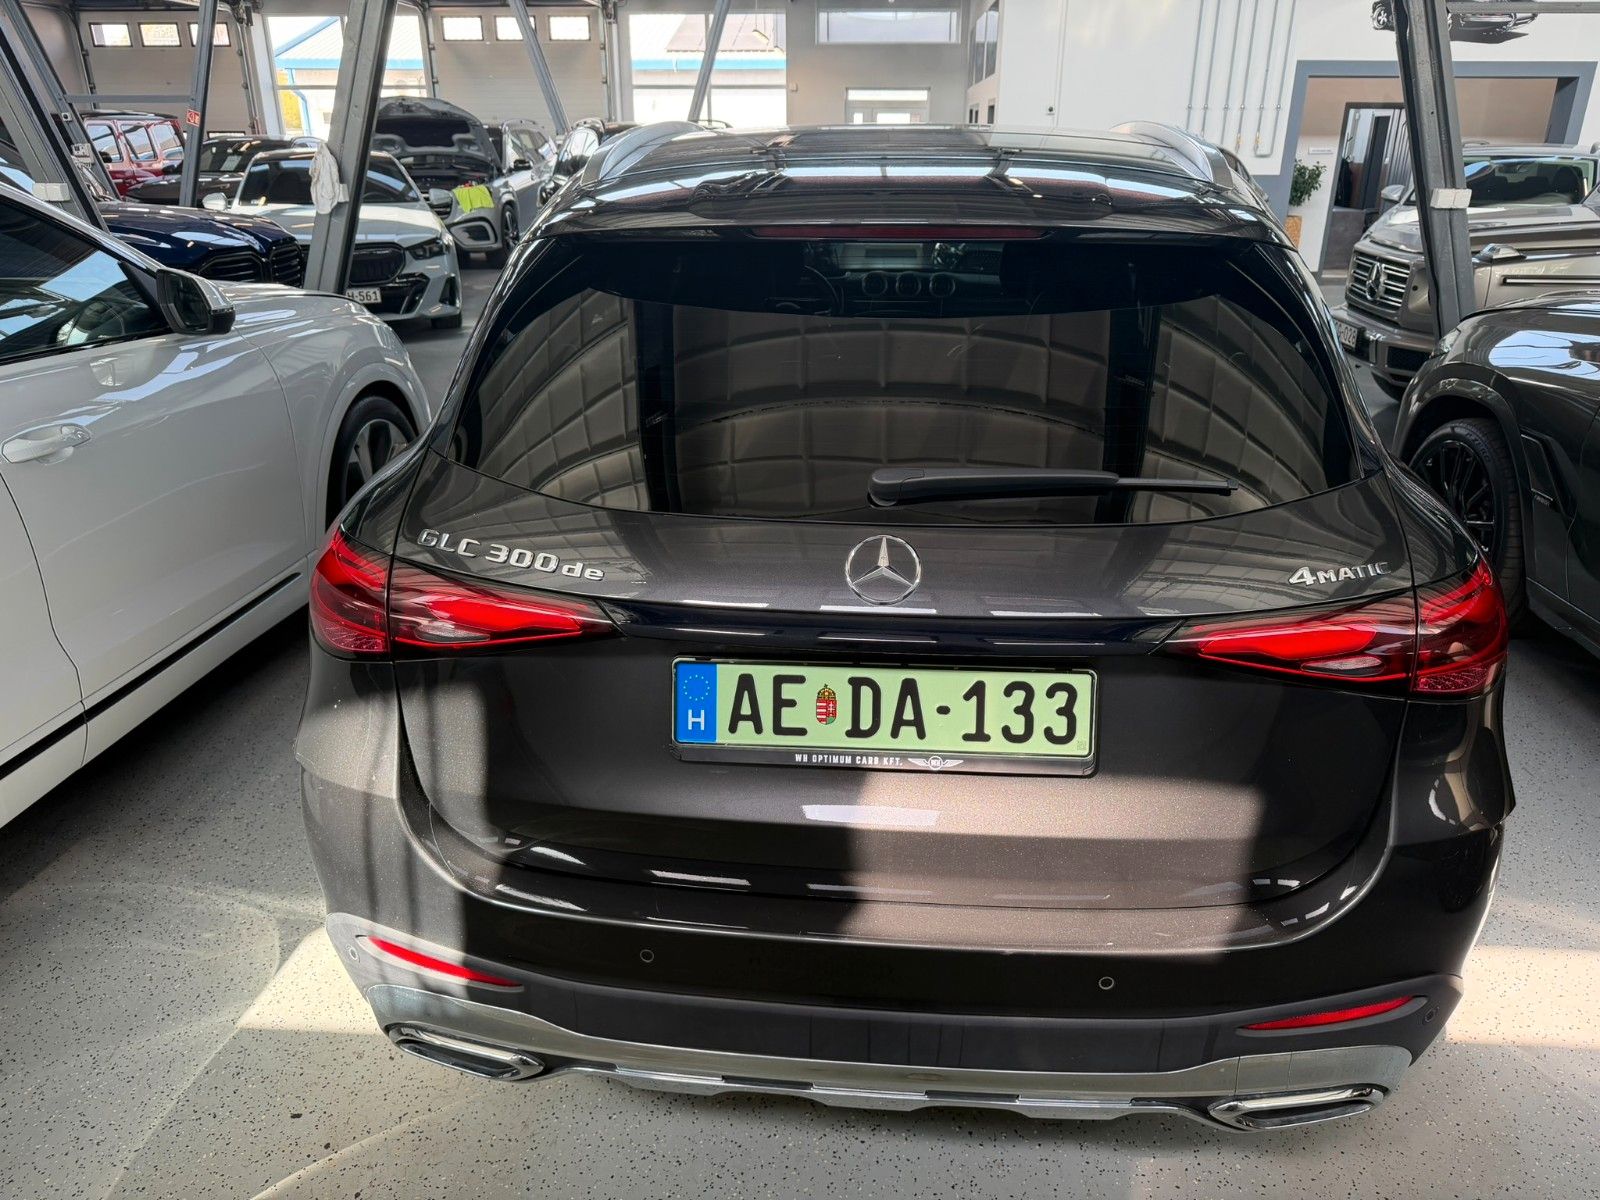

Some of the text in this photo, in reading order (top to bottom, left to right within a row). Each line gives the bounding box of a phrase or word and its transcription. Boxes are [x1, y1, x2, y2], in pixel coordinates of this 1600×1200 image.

[417, 528, 481, 557] GLC
[1288, 561, 1392, 586] 4MATIC
[687, 709, 705, 731] H
[728, 673, 1078, 745] AE DA-133
[812, 754, 852, 764] OPTIMUM
